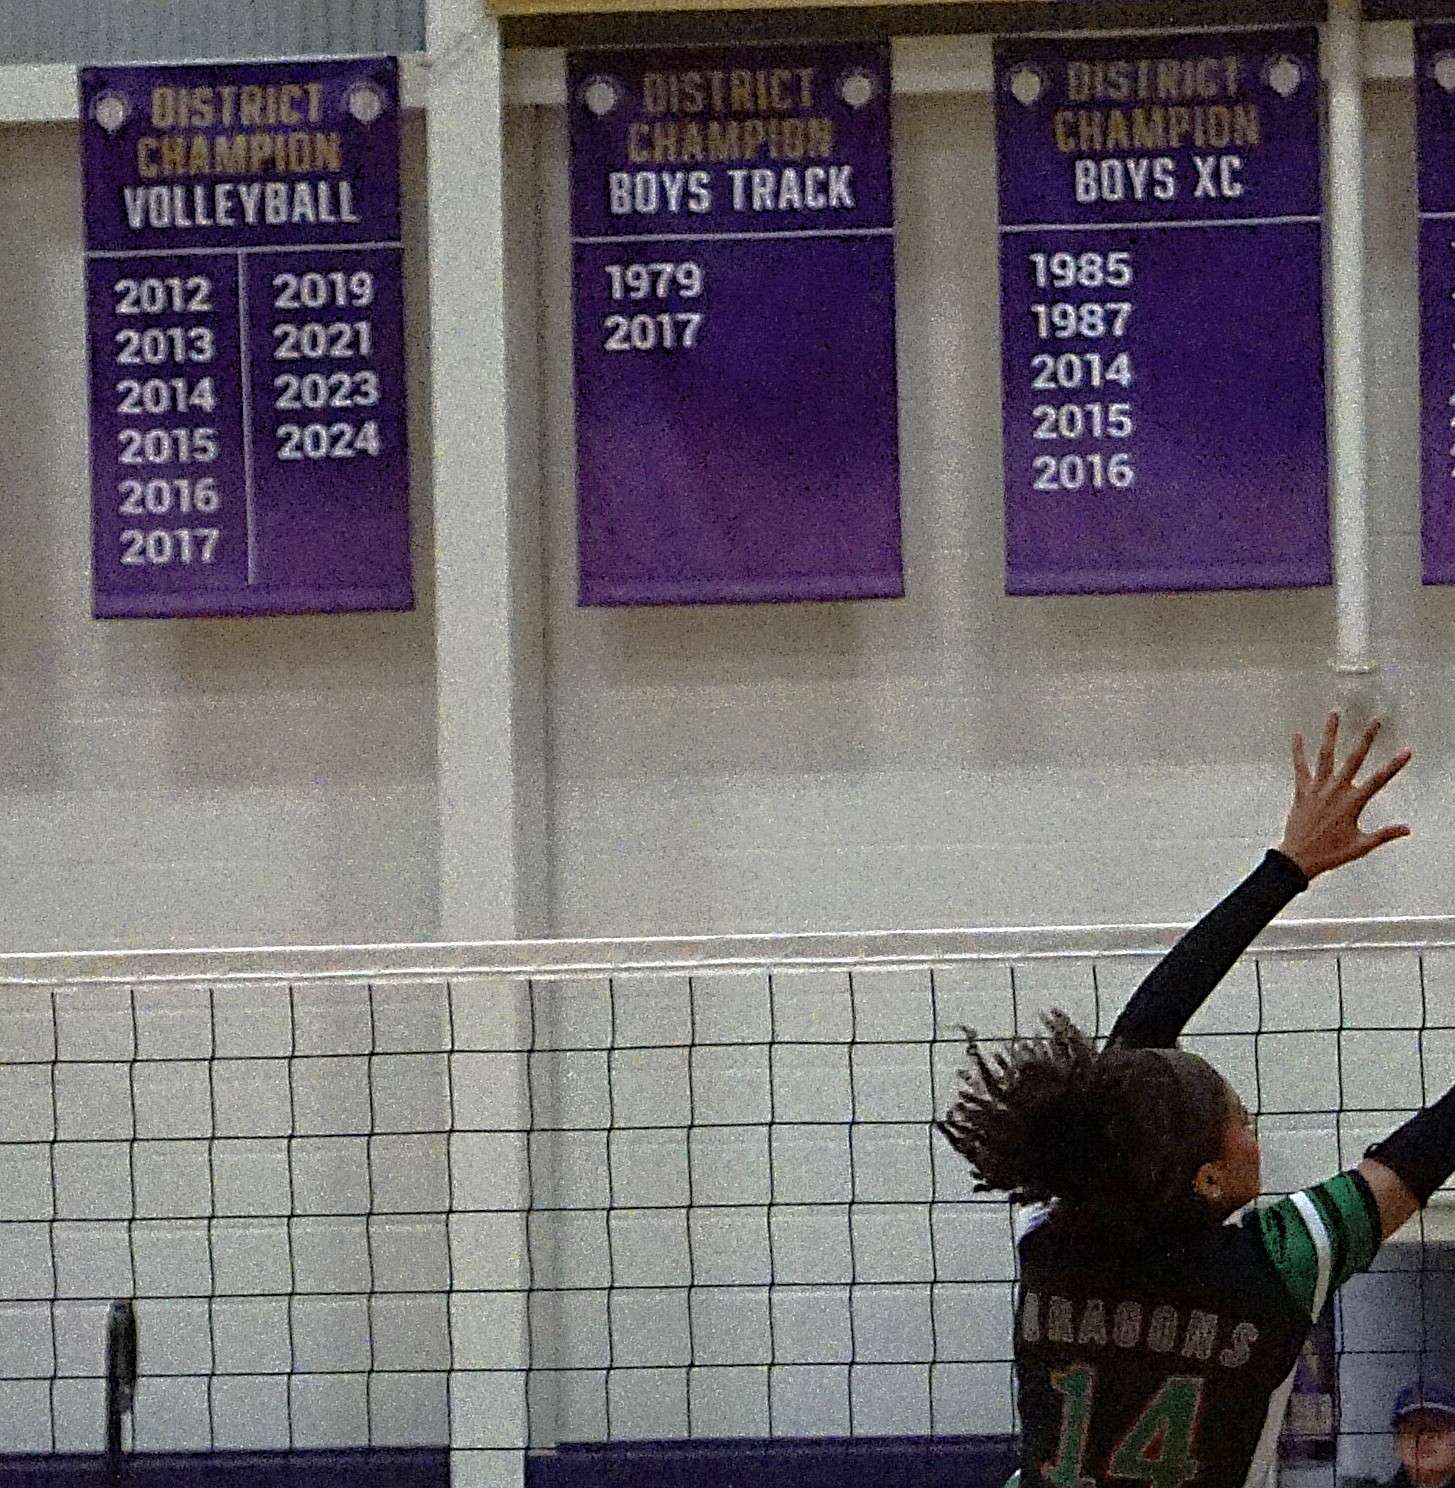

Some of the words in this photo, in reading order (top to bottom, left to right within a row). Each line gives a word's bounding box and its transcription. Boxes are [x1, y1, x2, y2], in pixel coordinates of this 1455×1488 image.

[644, 68, 813, 114] DISTRICT
[1068, 57, 1240, 101] DISTRICT
[151, 83, 322, 128] DISTRICT
[628, 118, 832, 163] CHAMPION
[1055, 106, 1259, 152] CHAMPION
[138, 131, 340, 177] CHAMPION
[611, 171, 711, 213] BOYS
[728, 166, 853, 210] TRACK
[1076, 157, 1175, 202] BOYS
[1194, 156, 1243, 197] XC
[125, 181, 357, 228] VOLLEYBALL
[606, 262, 702, 299] 1979
[1031, 252, 1132, 287] 1985
[115, 277, 211, 314] 2012
[273, 271, 373, 308] 2019
[605, 313, 702, 350] 2017
[1032, 302, 1132, 337] 1987
[116, 327, 213, 364] 2013
[274, 321, 370, 358] 2021
[1032, 353, 1132, 389] 2014
[117, 378, 215, 414] 2014
[275, 371, 379, 409] 2023
[1033, 403, 1133, 439] 2015
[119, 428, 217, 464] 2015
[278, 422, 380, 459] 2024
[1034, 453, 1134, 490] 2016
[119, 478, 219, 514] 2016
[121, 529, 219, 564] 2017
